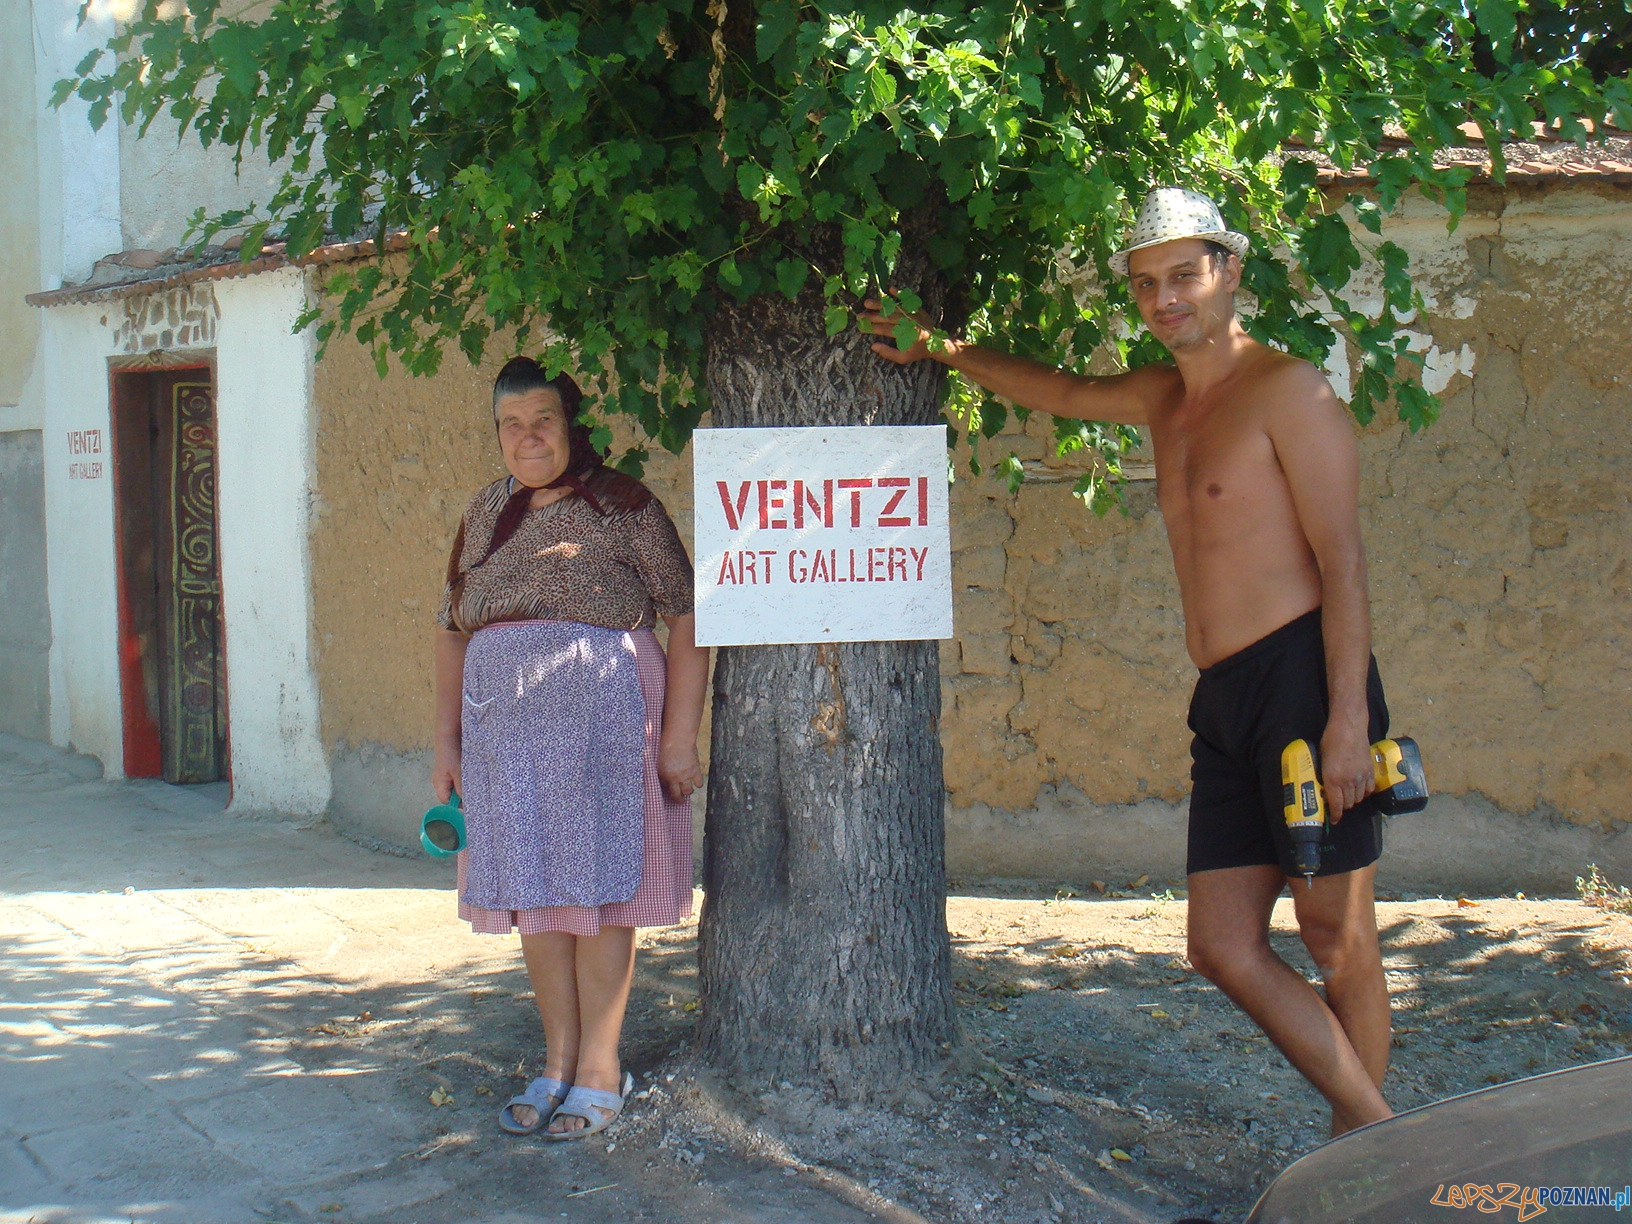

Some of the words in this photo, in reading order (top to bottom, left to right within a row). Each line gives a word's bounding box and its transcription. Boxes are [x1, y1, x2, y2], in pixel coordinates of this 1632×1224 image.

[67, 429, 102, 454] VENTZI
[79, 462, 102, 479] GALLERY
[716, 477, 928, 530] VENTZI
[717, 551, 777, 585] ART
[788, 547, 929, 583] GALLERY
